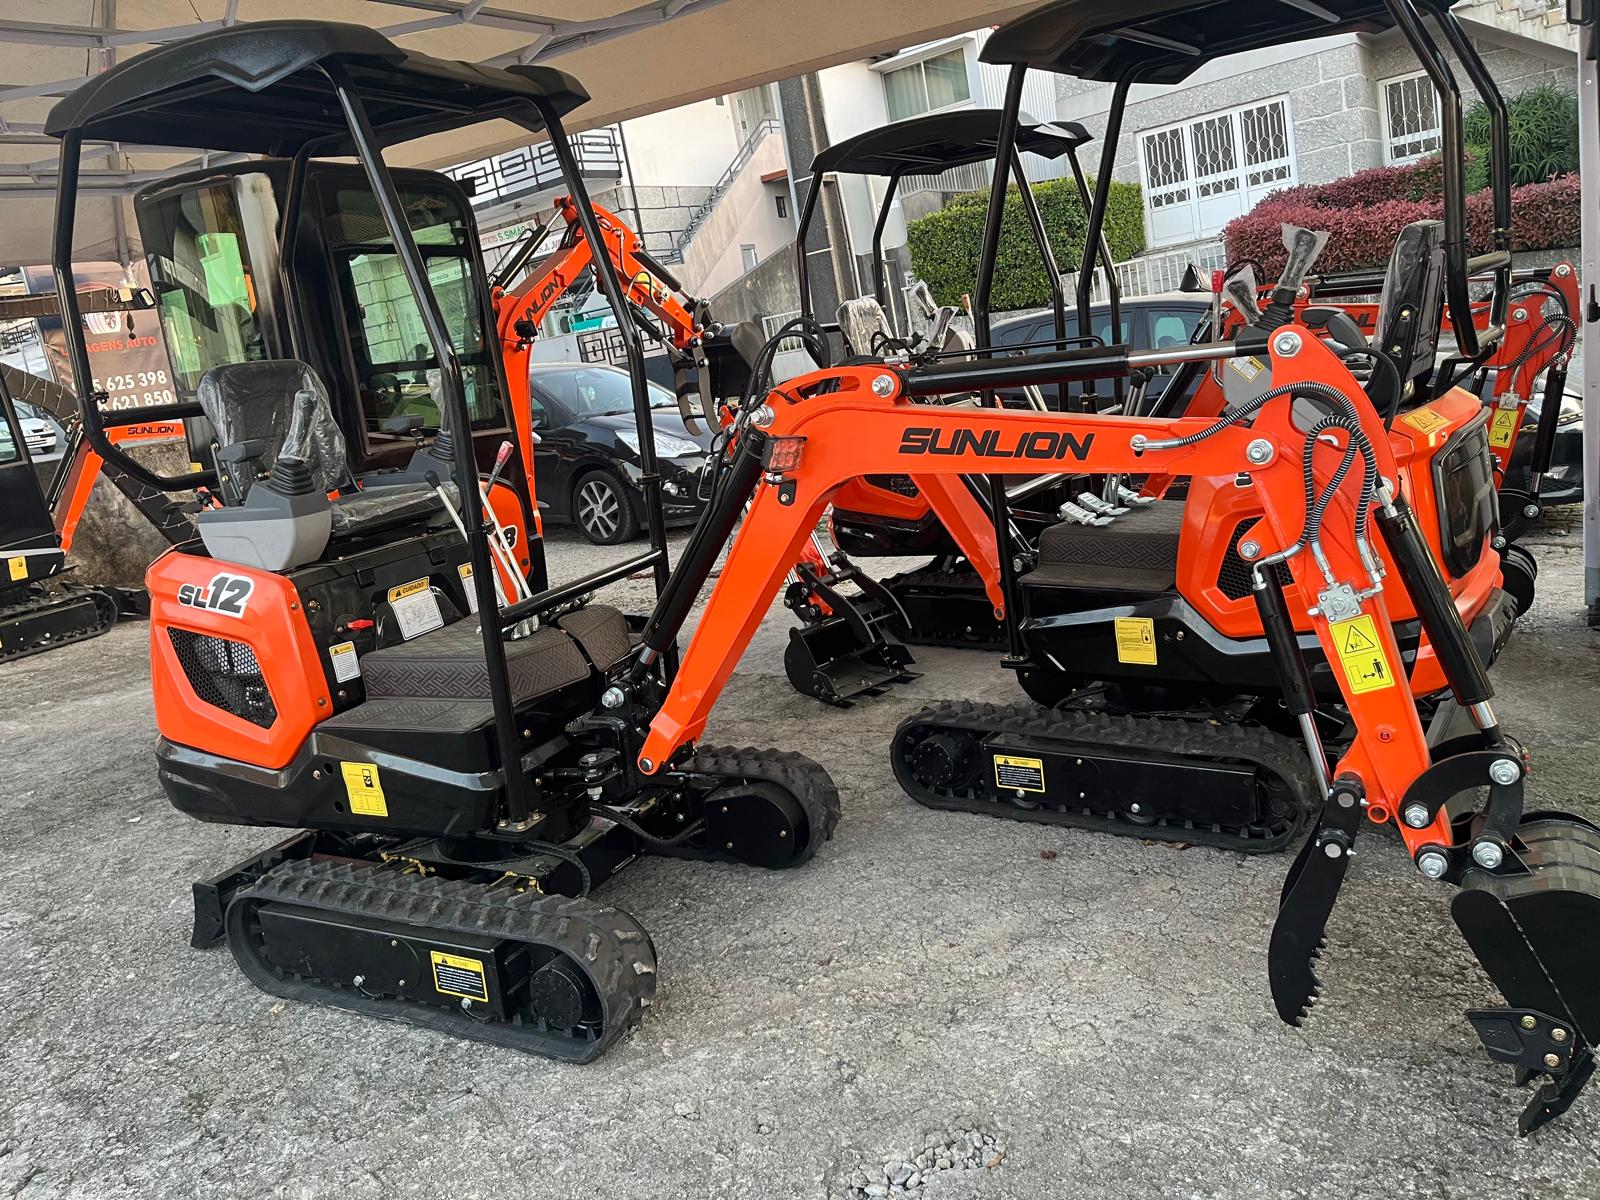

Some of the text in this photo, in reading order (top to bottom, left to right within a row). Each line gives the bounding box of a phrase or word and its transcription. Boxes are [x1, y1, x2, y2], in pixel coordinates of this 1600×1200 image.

[126, 336, 158, 348] AUTO
[106, 374, 135, 391] 625
[138, 369, 168, 386] 398
[112, 393, 139, 410] 621
[143, 389, 173, 407] 850
[127, 425, 175, 435] SUNLION
[898, 427, 1096, 461] SUNLION
